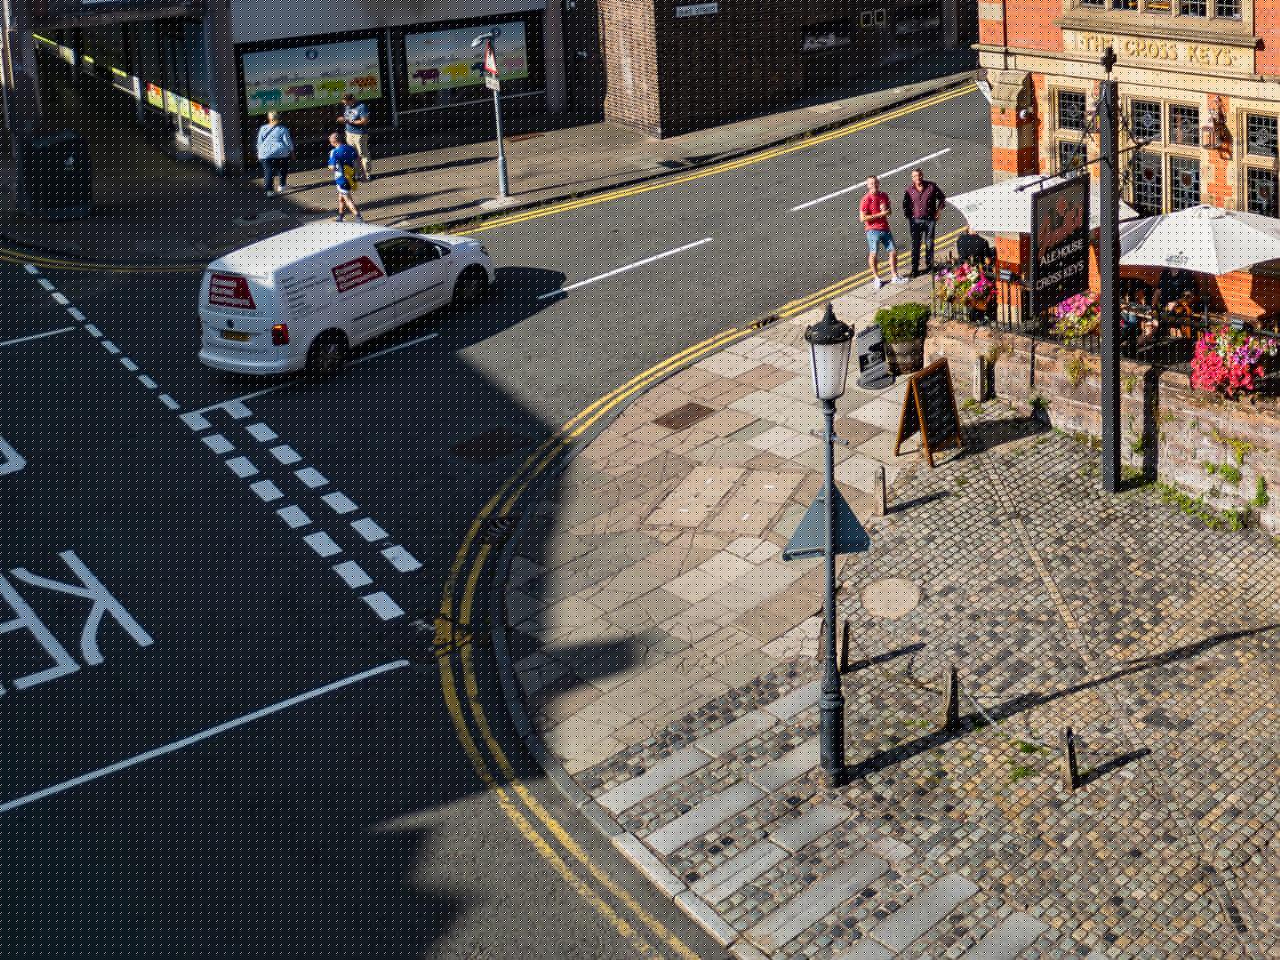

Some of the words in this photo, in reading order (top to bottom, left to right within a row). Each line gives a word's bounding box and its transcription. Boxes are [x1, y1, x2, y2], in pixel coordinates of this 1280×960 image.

[1083, 32, 1113, 53] THE
[1123, 39, 1178, 62] CROSS
[1187, 45, 1232, 66] KEYS
[1040, 250, 1058, 266] ALE
[1058, 238, 1084, 259] HOUSE
[1036, 269, 1062, 291] CROSS
[1063, 261, 1085, 281] KEYS
